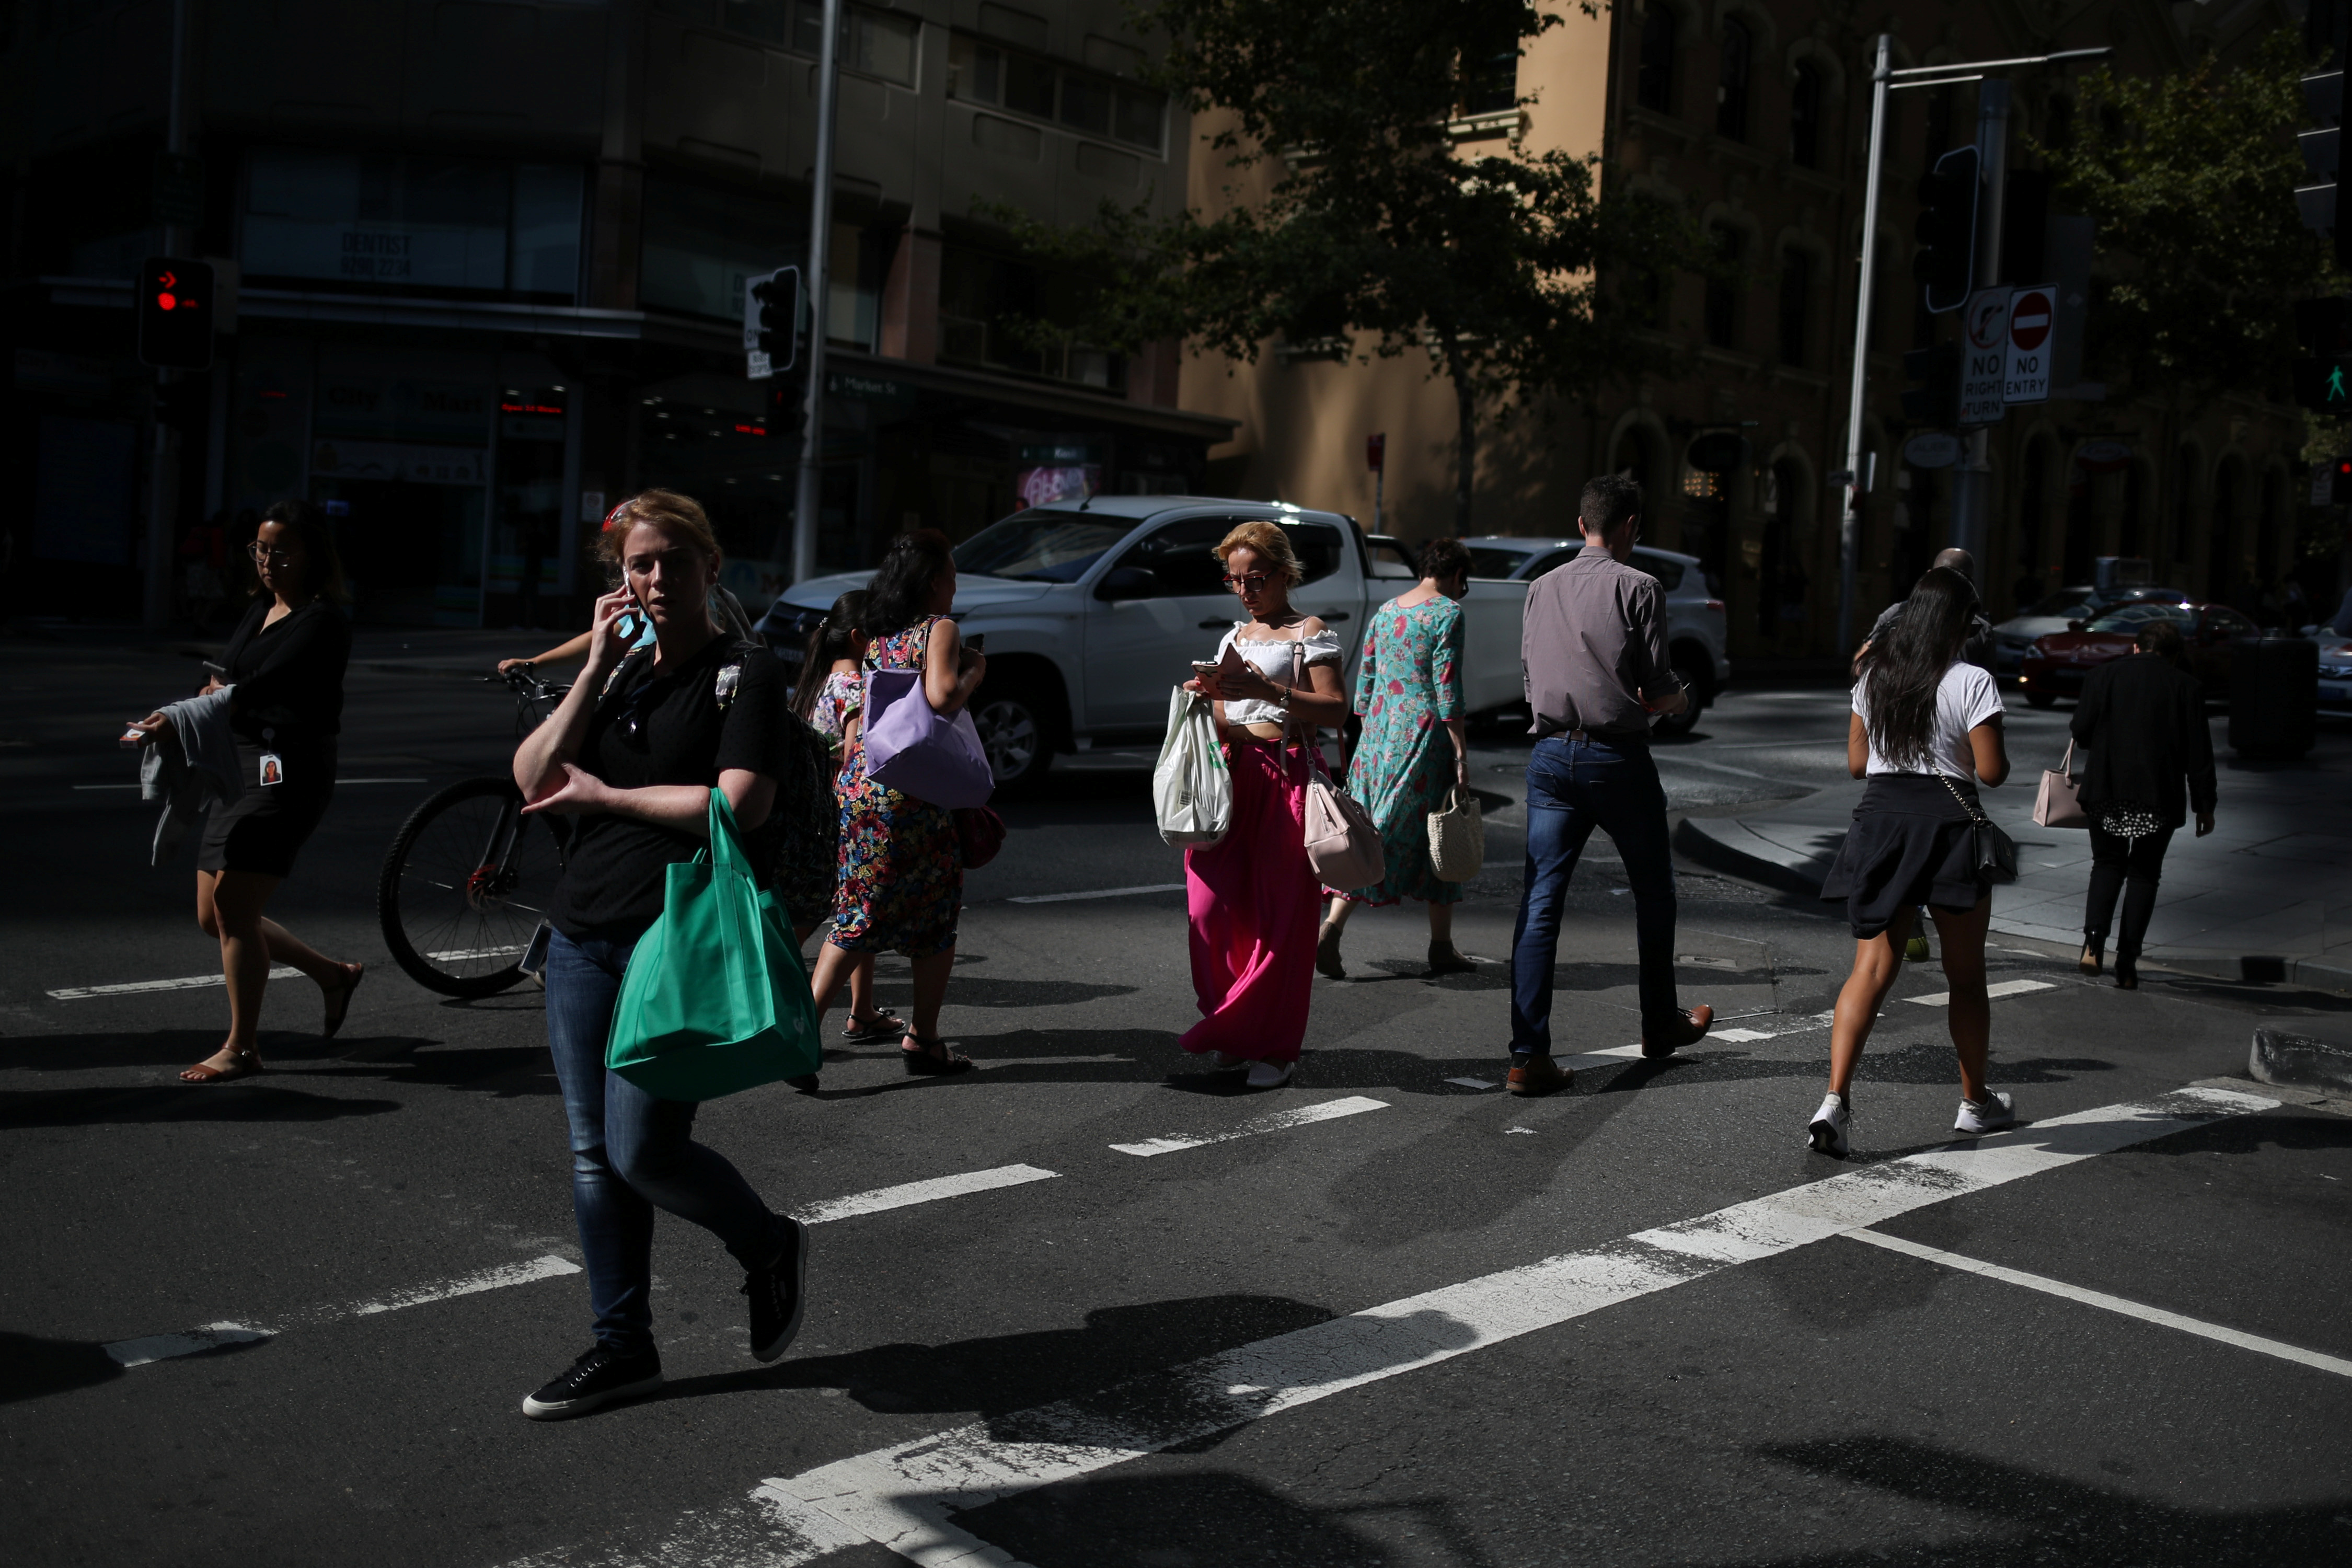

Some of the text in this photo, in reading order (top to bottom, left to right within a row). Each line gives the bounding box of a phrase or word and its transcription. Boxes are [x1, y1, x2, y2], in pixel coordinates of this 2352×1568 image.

[343, 233, 412, 255] DENTIST
[378, 258, 411, 276] 2234
[1973, 355, 1999, 376] NO
[2017, 356, 2038, 374] NO
[845, 376, 896, 395] Market St
[1966, 381, 2002, 396] RIGHT
[2006, 379, 2046, 395] ENTRY
[327, 386, 378, 412] City
[422, 392, 480, 413] Mart
[1966, 400, 2000, 415] TURN
